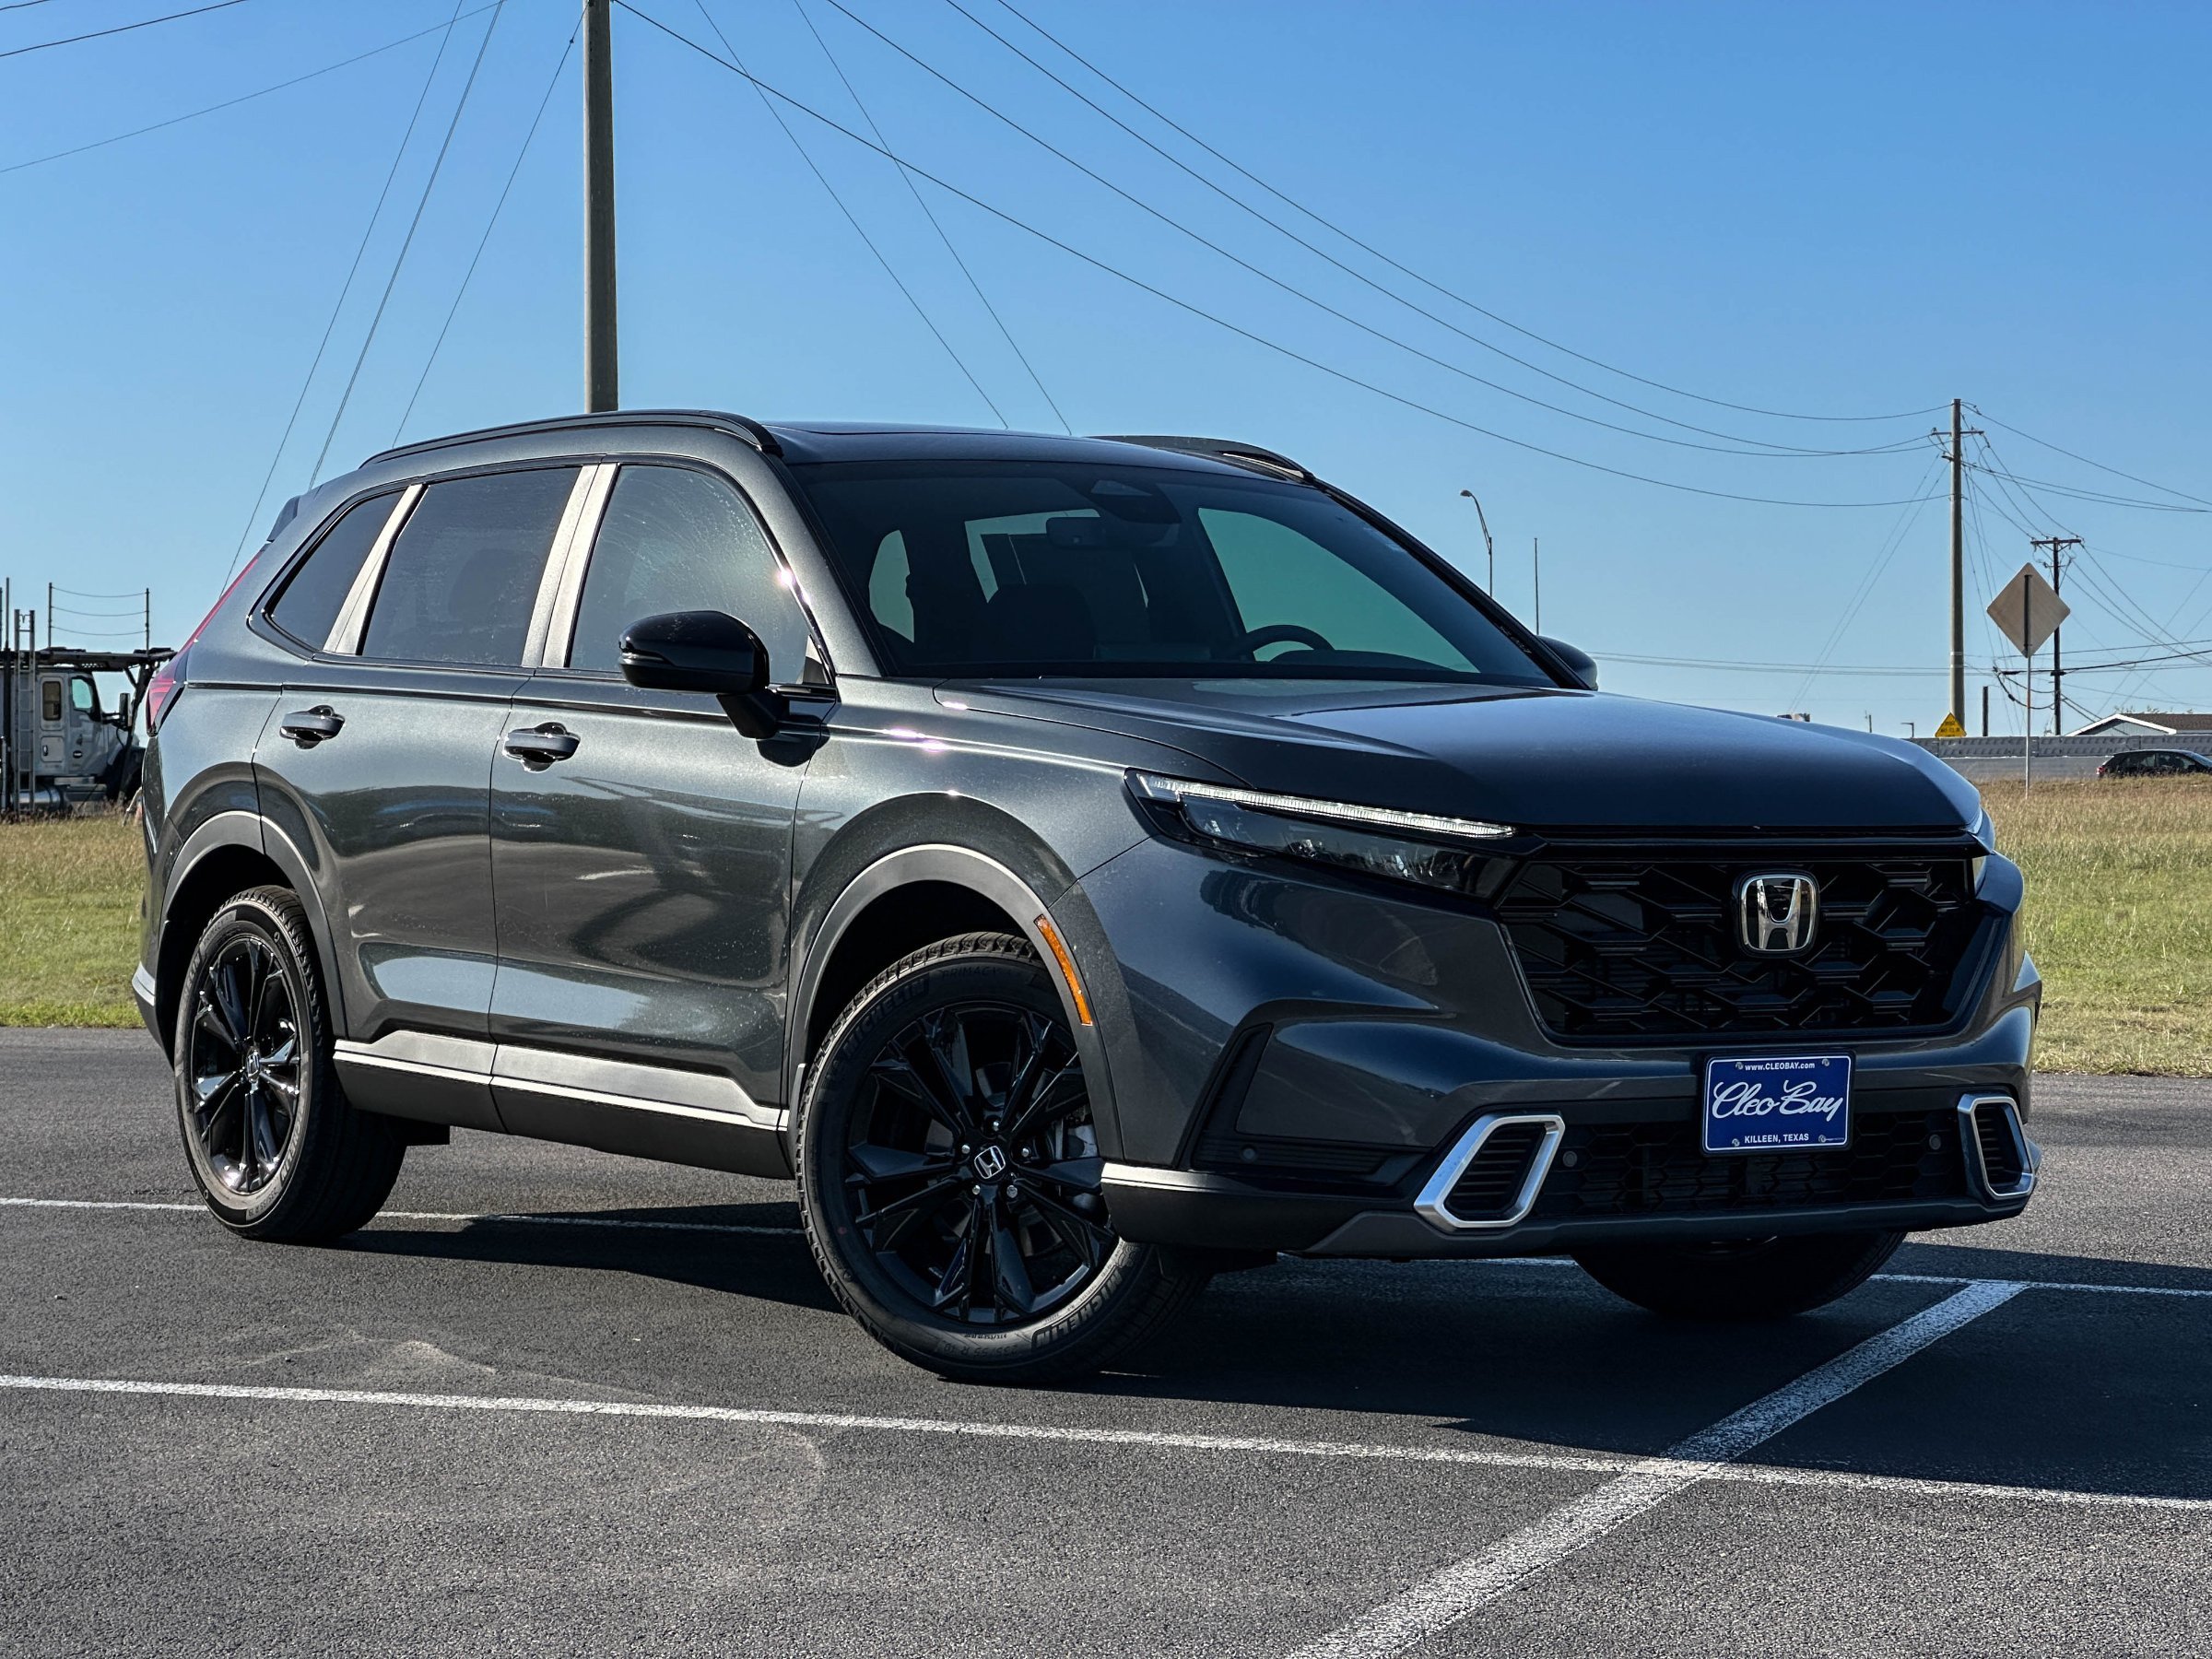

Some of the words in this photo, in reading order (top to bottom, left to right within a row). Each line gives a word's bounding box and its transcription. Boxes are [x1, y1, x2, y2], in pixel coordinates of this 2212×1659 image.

[1745, 1062, 1816, 1071] www.CLEOBAY.com
[1712, 1081, 1781, 1119] Cleo
[1778, 1080, 1844, 1123] Bay
[1744, 1134, 1782, 1144] KILLEEN,
[1783, 1133, 1809, 1143] TEXAS
[1035, 1268, 1124, 1348] MICHELIN
